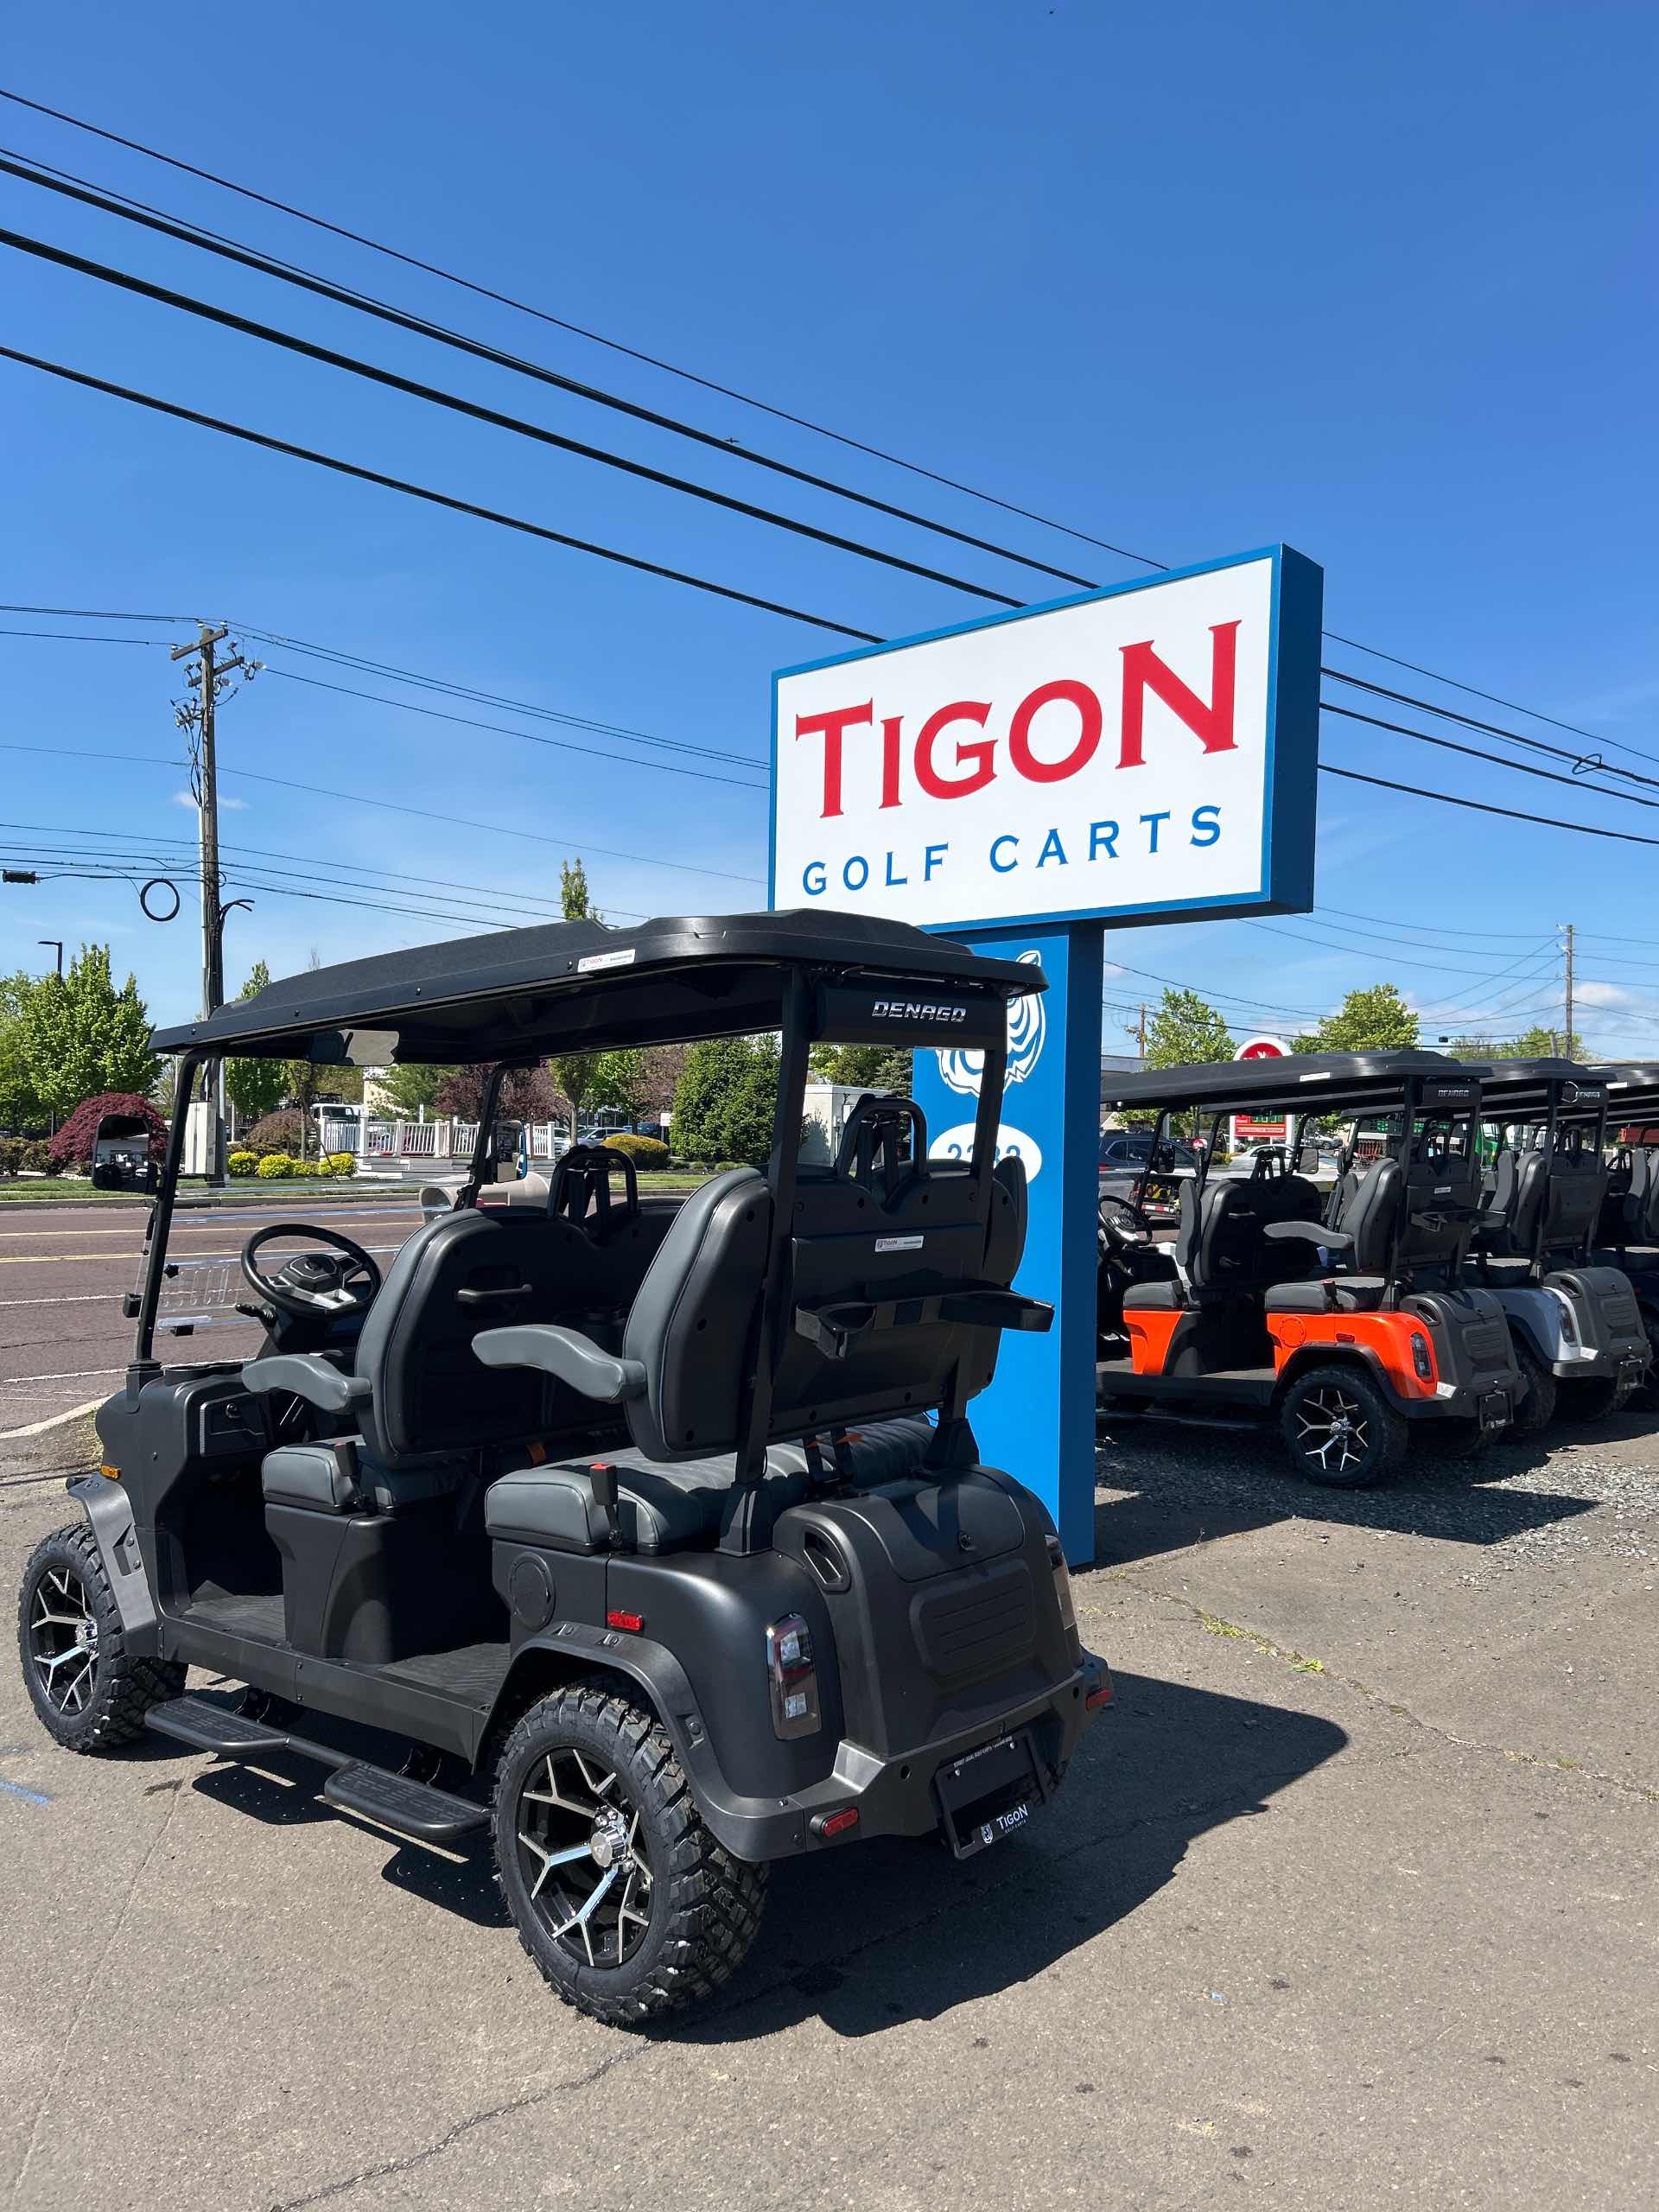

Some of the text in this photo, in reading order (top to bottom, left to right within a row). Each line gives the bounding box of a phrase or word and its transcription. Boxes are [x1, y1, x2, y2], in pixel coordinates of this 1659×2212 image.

[796, 620, 1242, 818] TIGON
[803, 805, 1222, 896] GOLF CARTS
[872, 1001, 966, 1022] DENAGO
[996, 1803, 1028, 1829] TIGON
